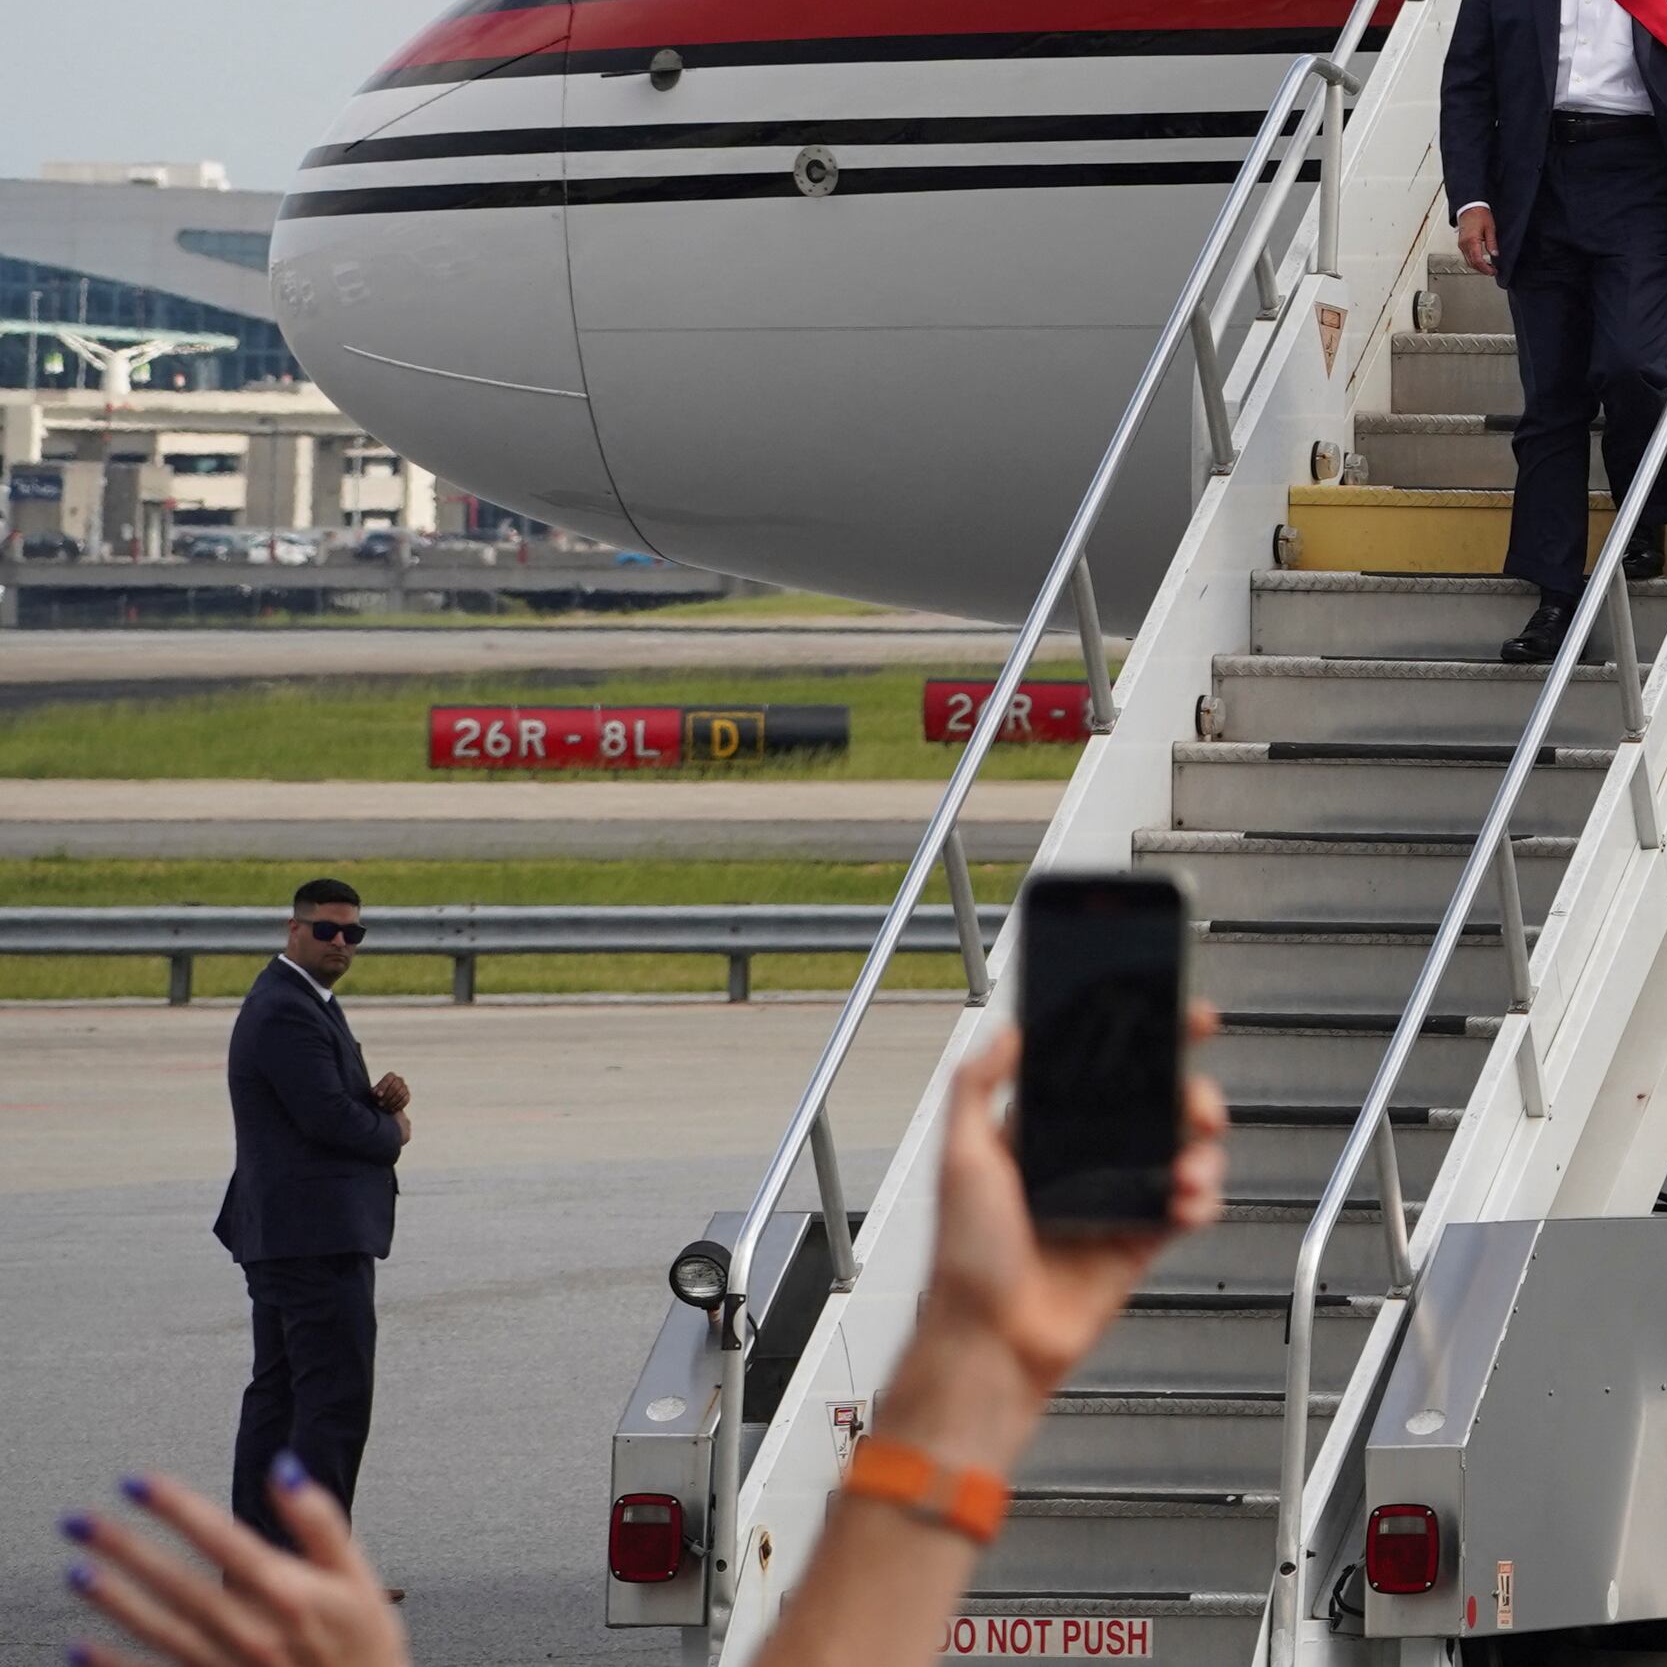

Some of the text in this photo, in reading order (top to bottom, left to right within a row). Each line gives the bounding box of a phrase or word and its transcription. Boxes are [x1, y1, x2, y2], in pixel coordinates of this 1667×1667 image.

[946, 693, 1033, 733] 2R
[452, 718, 547, 759] 26R
[601, 719, 661, 759] 8L
[711, 719, 740, 759] D
[987, 1619, 1053, 1654] NOT
[1063, 1620, 1147, 1655] PUSH
